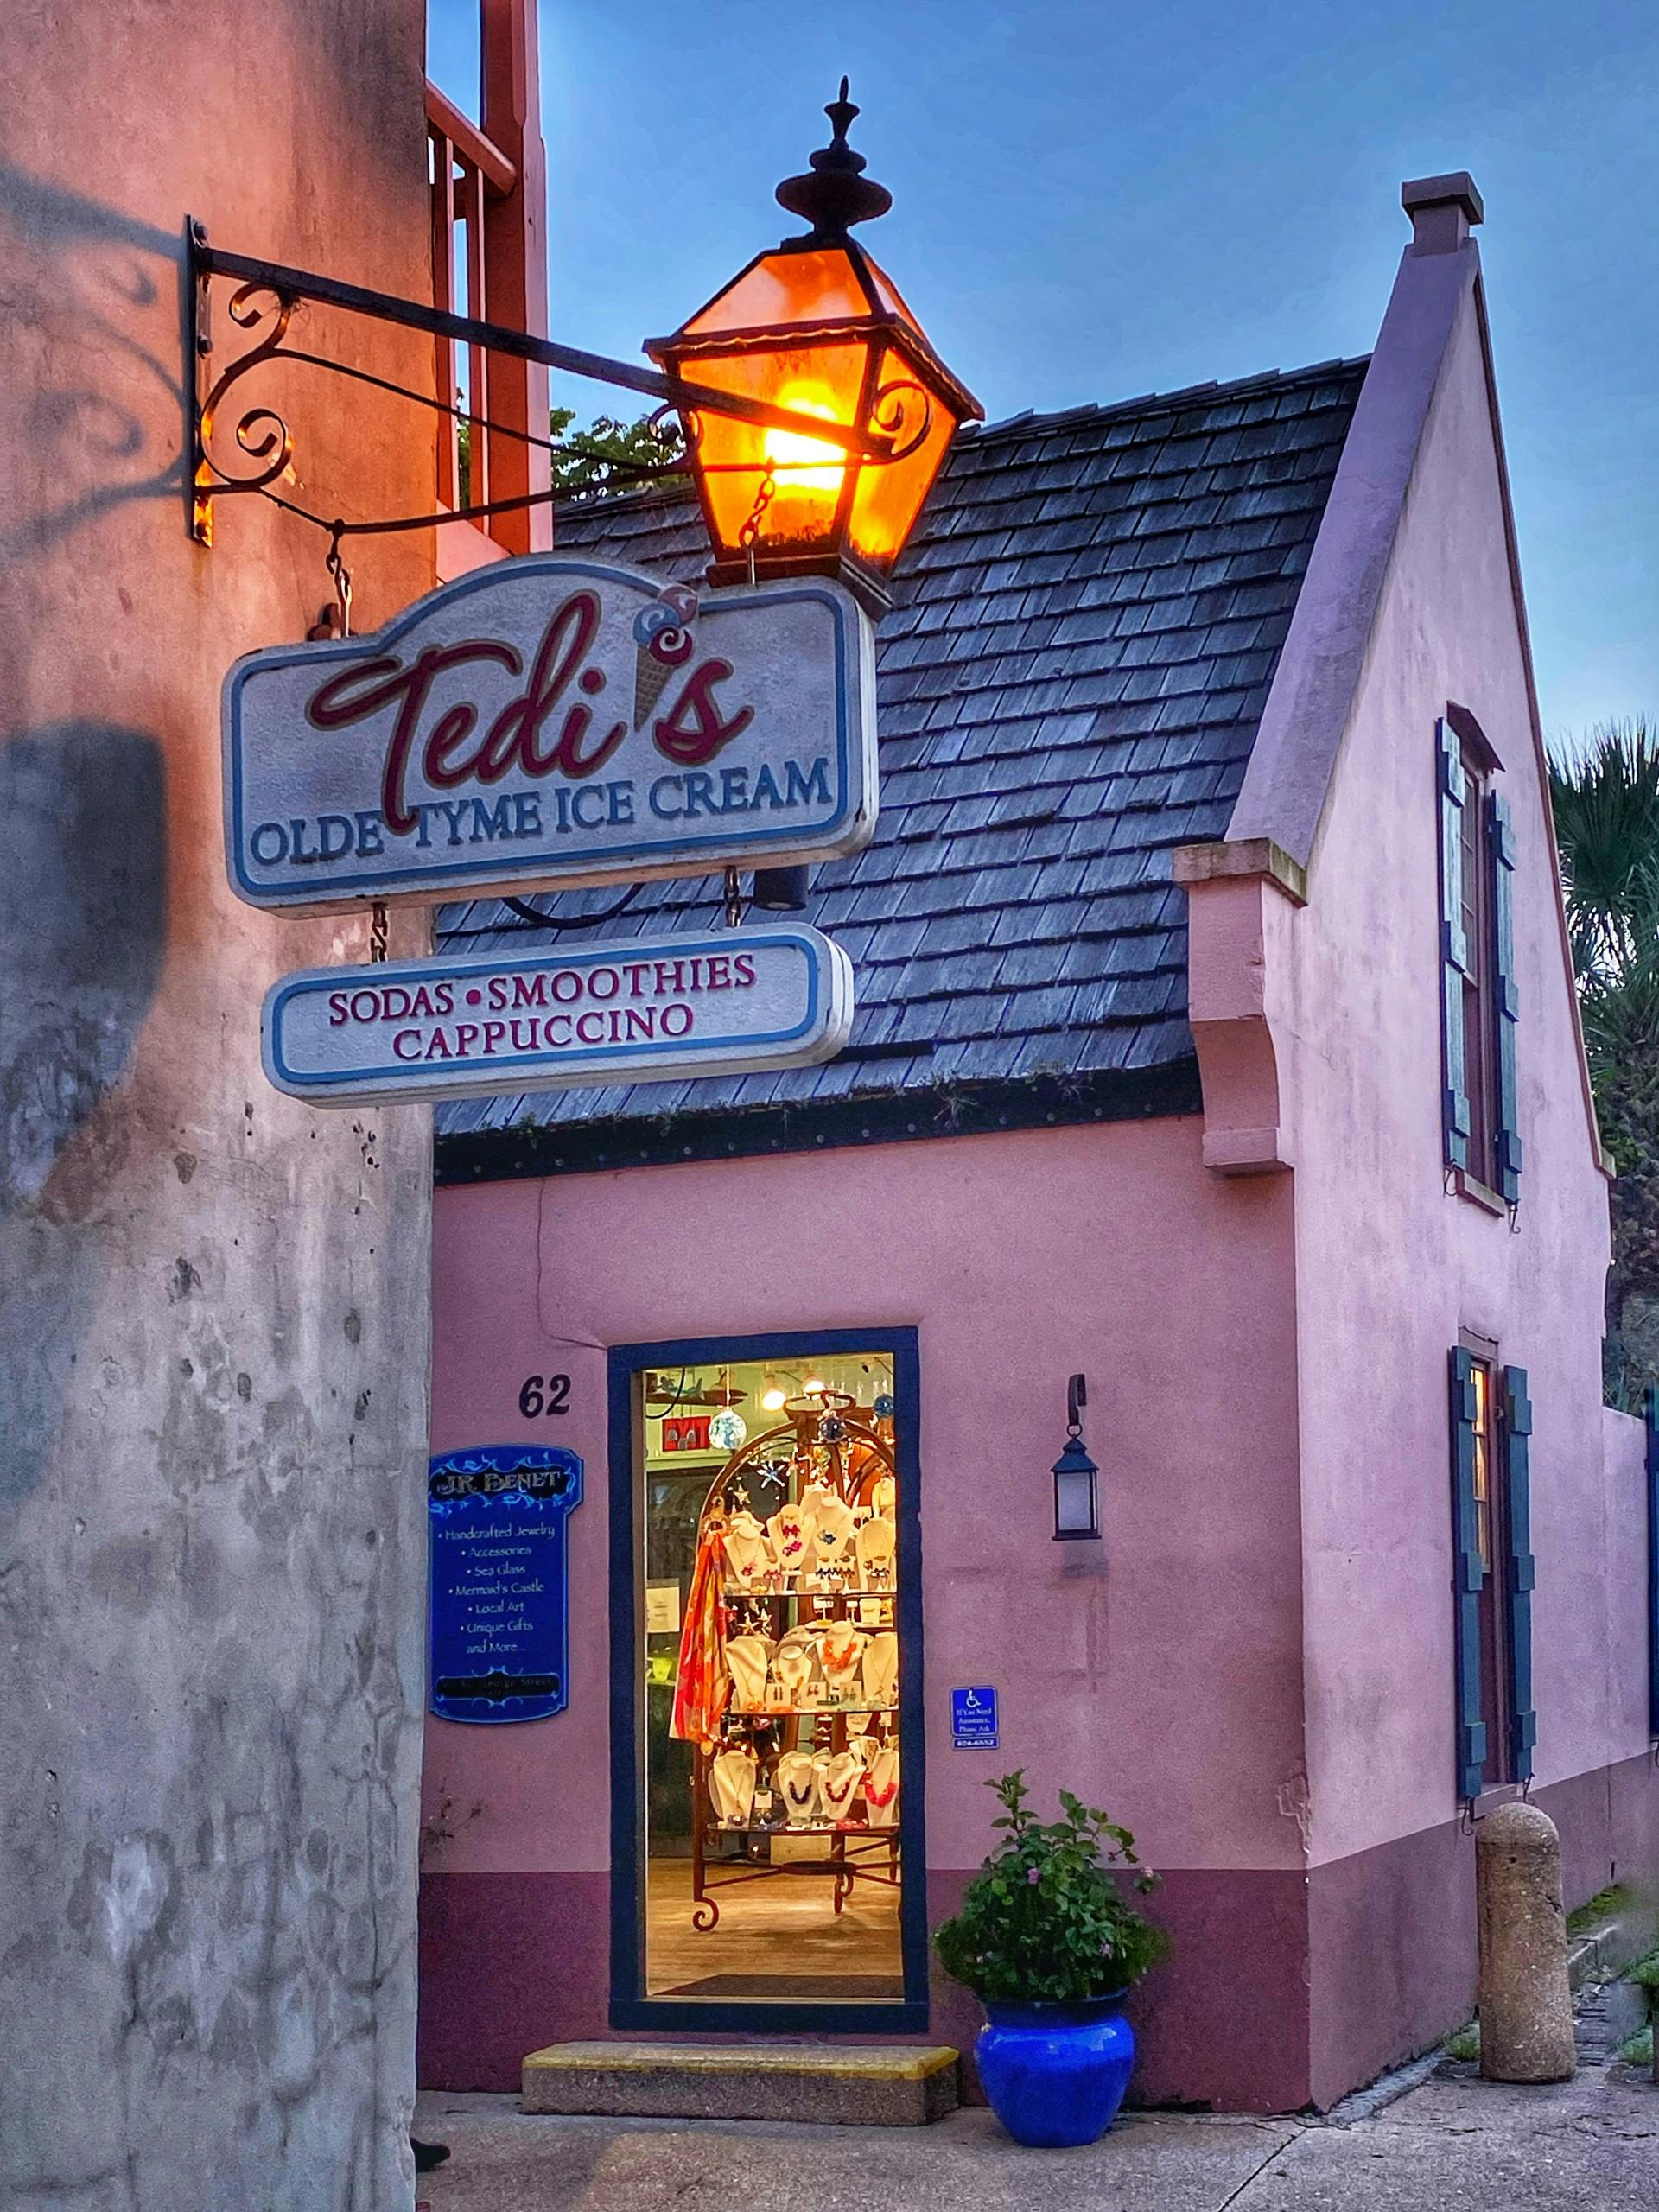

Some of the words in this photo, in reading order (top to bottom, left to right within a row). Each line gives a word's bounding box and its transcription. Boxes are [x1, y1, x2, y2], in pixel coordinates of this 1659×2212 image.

[306, 589, 754, 834] Tedi's
[250, 810, 386, 866] OLDE
[407, 791, 543, 848] TYME
[555, 779, 635, 834] ICE
[649, 757, 834, 820] CREAM
[328, 982, 454, 1026] SODAS
[489, 953, 756, 1010] SMOOTHIES
[392, 1003, 694, 1061] CAPPUCCINO
[519, 1374, 571, 1418] 62
[483, 1471, 561, 1492] BENET
[445, 1523, 512, 1541] Handcrafted
[514, 1521, 556, 1540] Jewelry
[468, 1546, 532, 1558] Accessories
[474, 1566, 494, 1577] Sea
[497, 1561, 525, 1575] Glass
[455, 1580, 508, 1596] Mermaid's
[511, 1577, 544, 1593] Castle
[475, 1599, 505, 1614] Local
[506, 1601, 524, 1612] Art
[467, 1624, 505, 1638] Unique
[507, 1617, 533, 1632] Gifts
[467, 1639, 486, 1654] and
